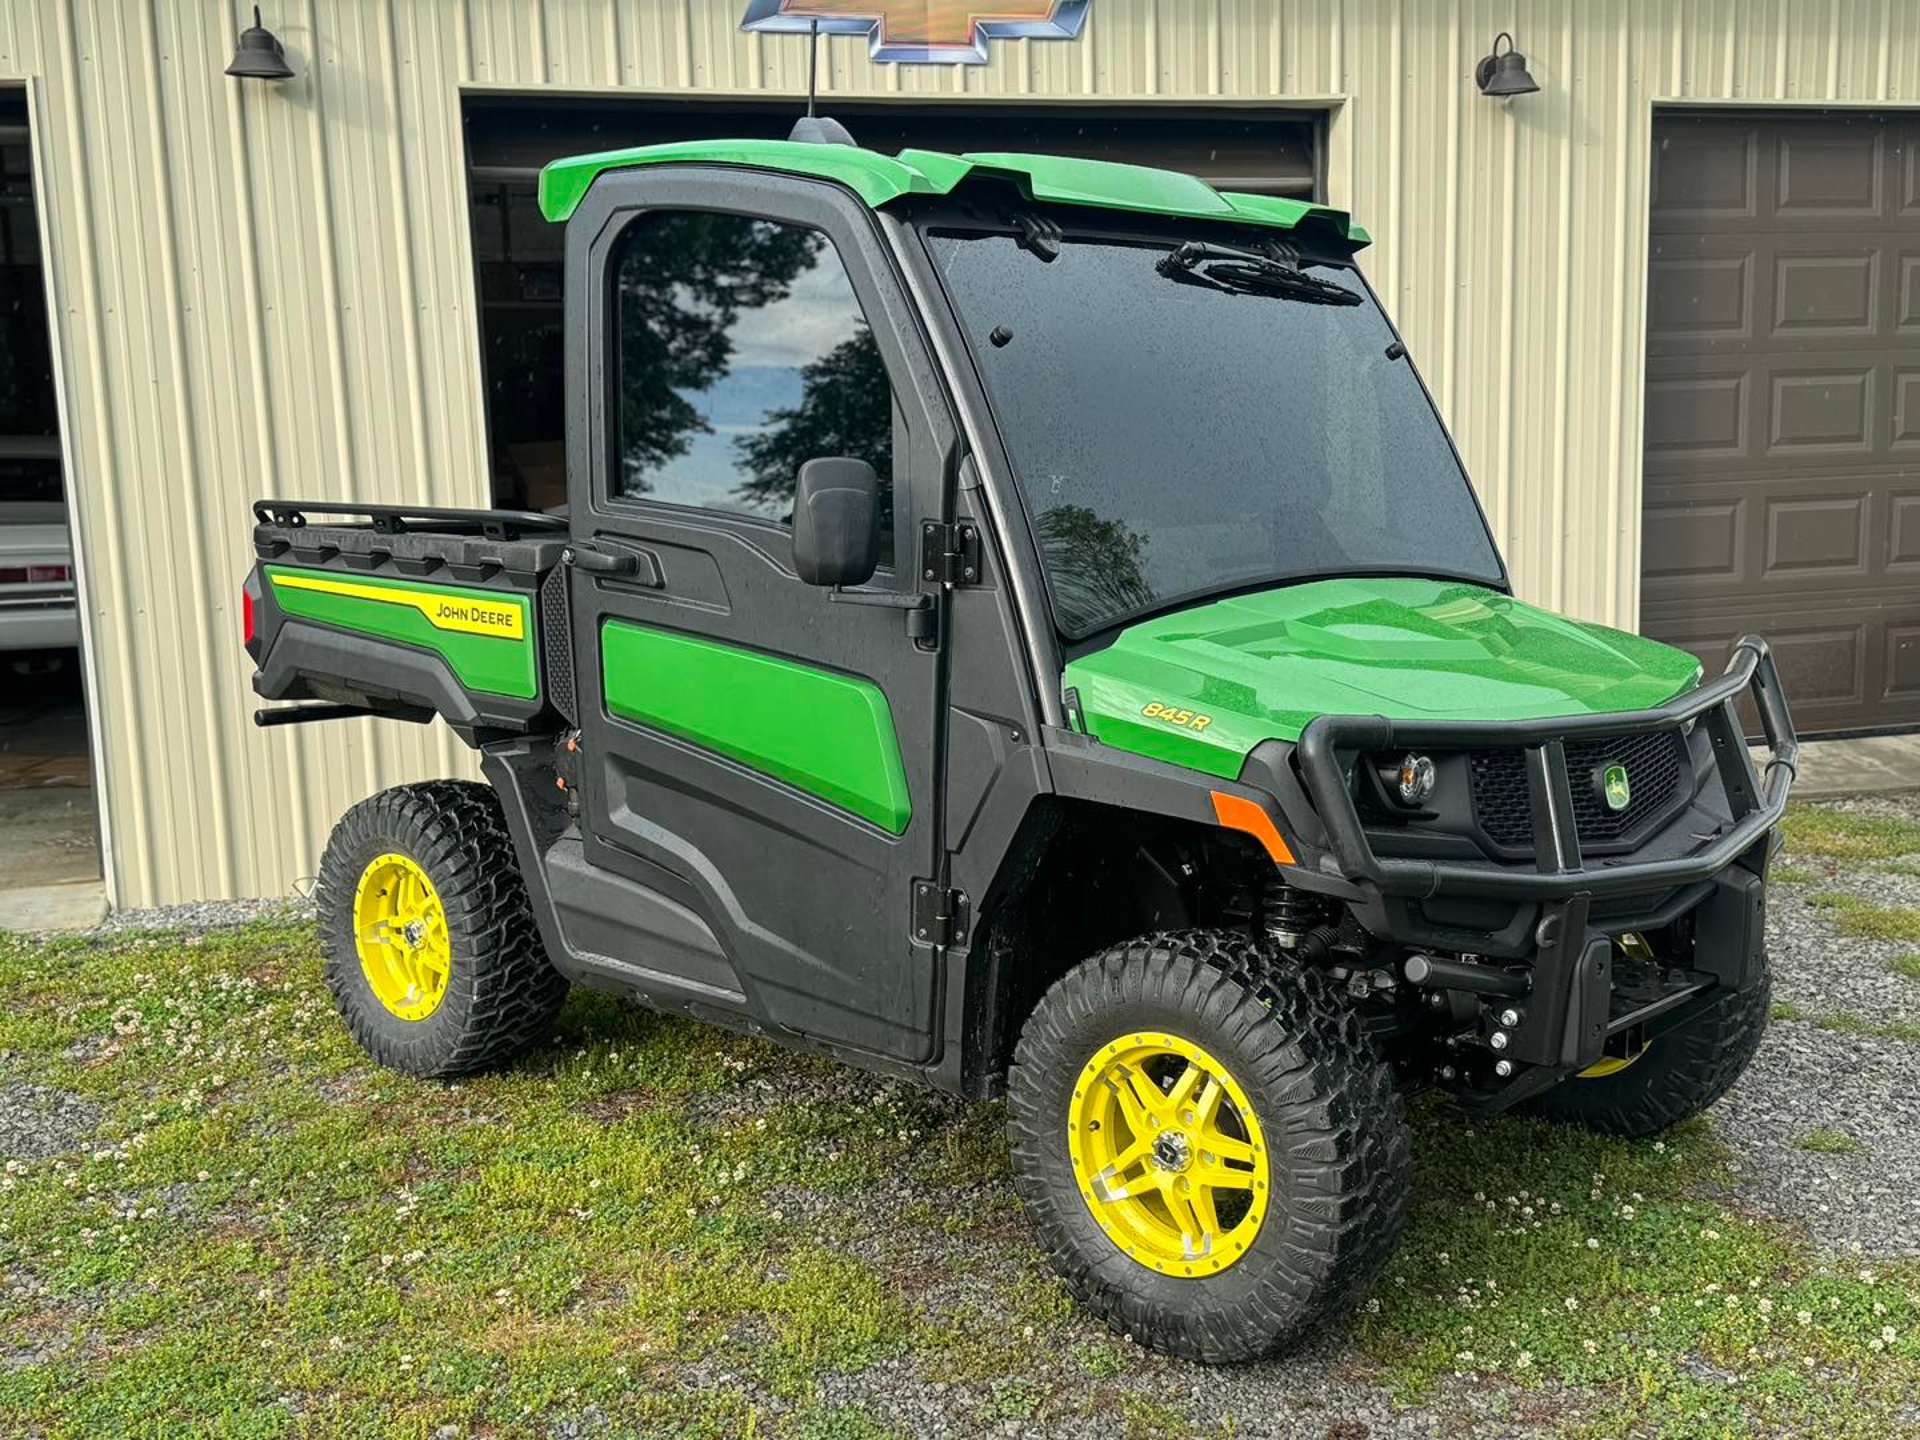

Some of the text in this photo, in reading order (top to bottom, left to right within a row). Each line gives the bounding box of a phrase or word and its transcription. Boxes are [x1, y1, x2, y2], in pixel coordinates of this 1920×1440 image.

[436, 603, 513, 627] JOHN DEERE
[1141, 701, 1213, 732] 845R
